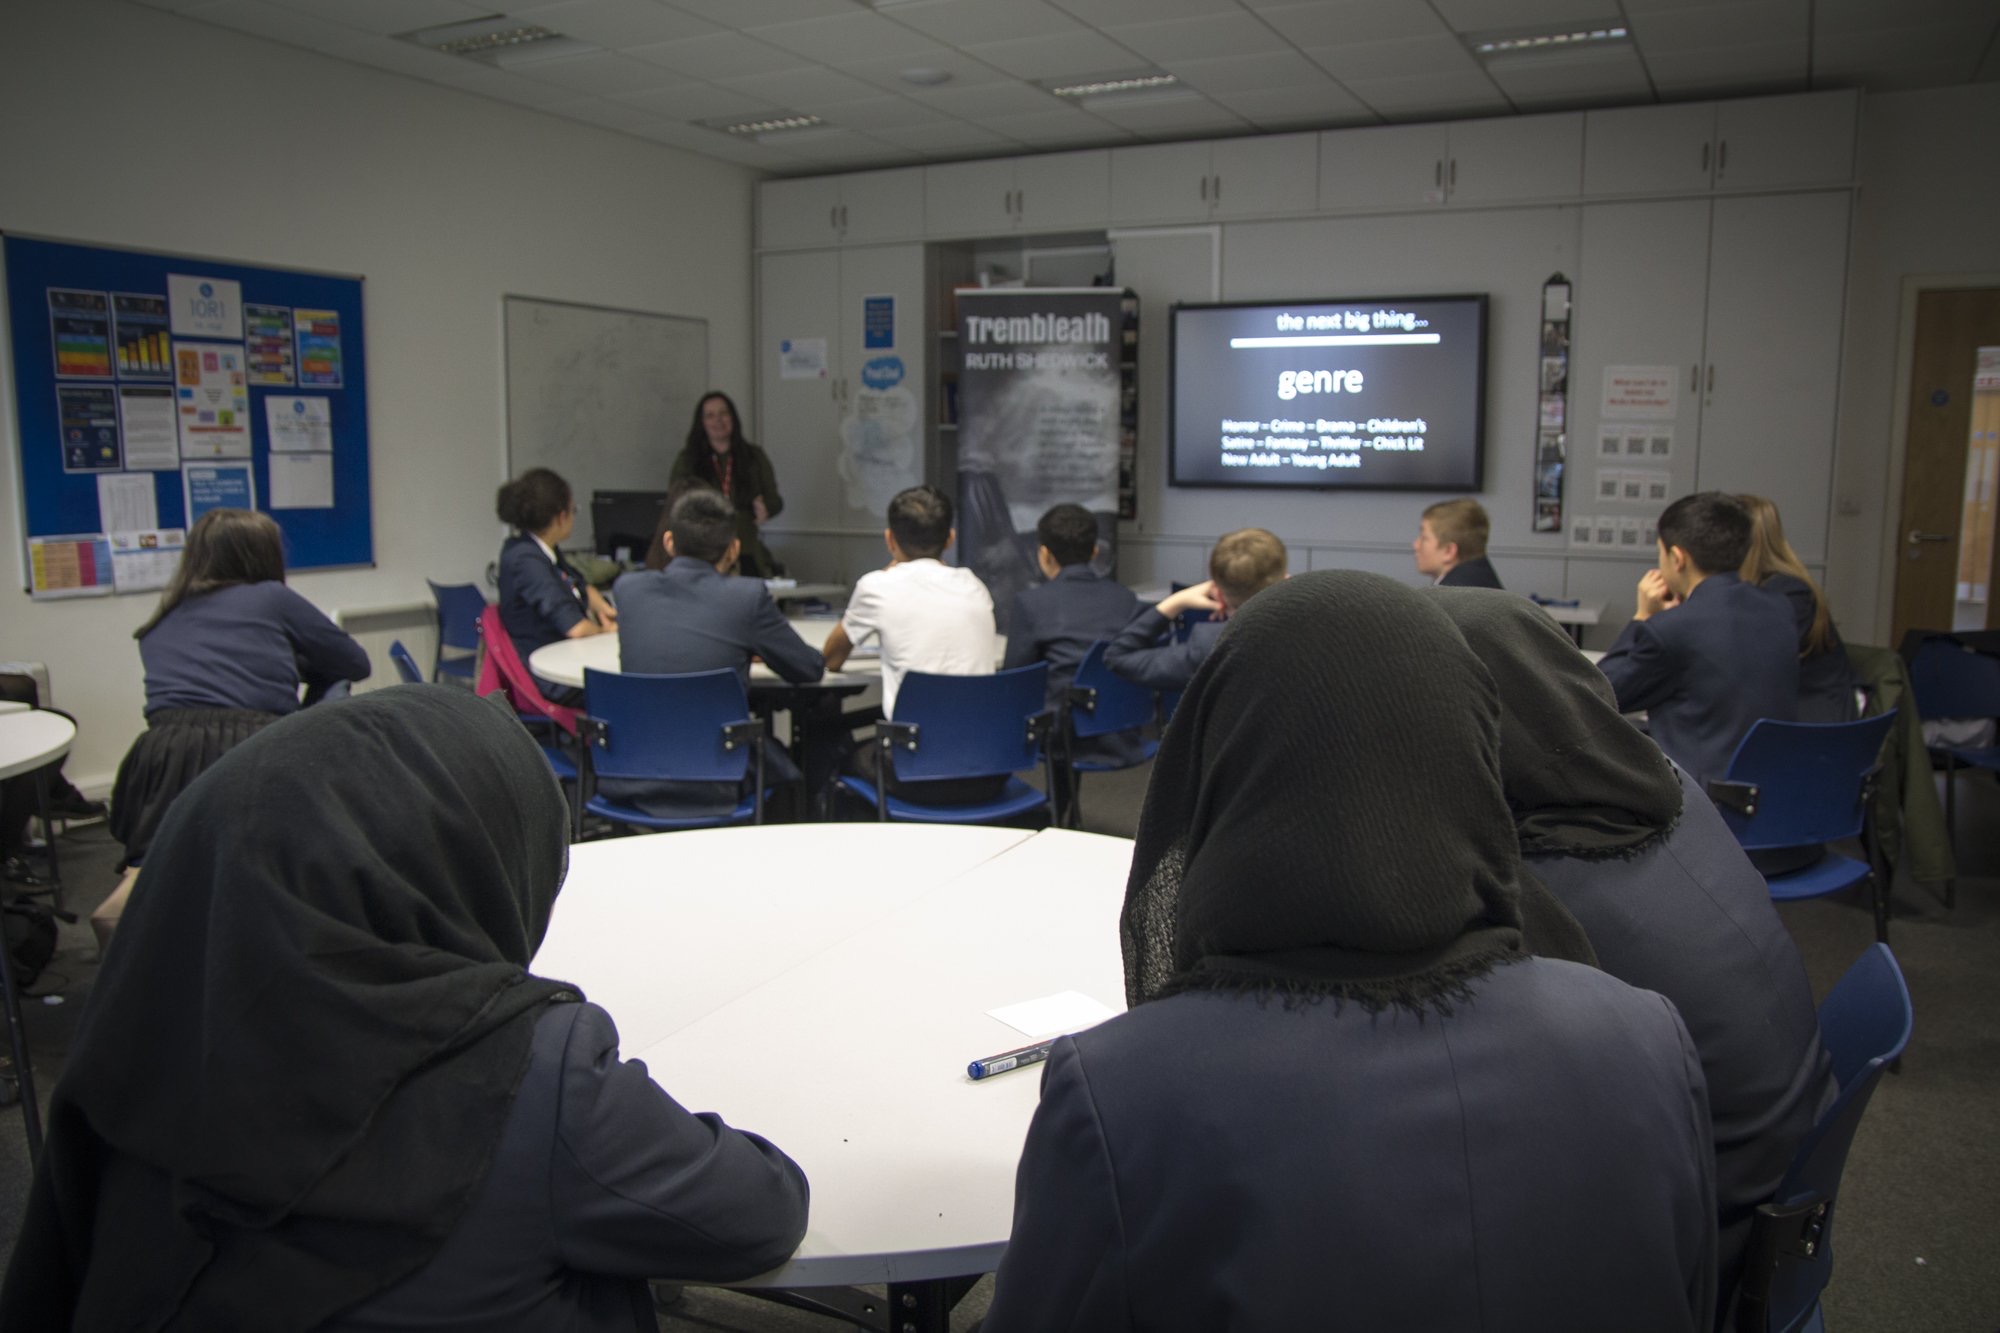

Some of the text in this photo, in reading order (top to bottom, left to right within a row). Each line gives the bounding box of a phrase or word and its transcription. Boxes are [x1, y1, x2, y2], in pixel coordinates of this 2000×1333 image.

[966, 312, 1110, 344] Trembleath
[1277, 312, 1304, 331] the
[1306, 313, 1343, 330] next
[1344, 310, 1370, 333] big
[966, 352, 1014, 370] RUTH
[1278, 370, 1363, 400] genre
[1222, 419, 1260, 433] Horror
[1270, 418, 1306, 433] Crime
[1316, 418, 1356, 433] Drama
[1366, 418, 1427, 433] Children's
[1221, 435, 1255, 450] Satire
[1265, 435, 1309, 452] Fantasy
[1319, 435, 1362, 450] Thriller
[1372, 435, 1406, 451] Chick
[1407, 436, 1424, 451] Lit
[1221, 452, 1249, 467] New
[1248, 452, 1280, 467] Adult
[1291, 452, 1327, 469] Young
[1327, 452, 1361, 468] Adult
